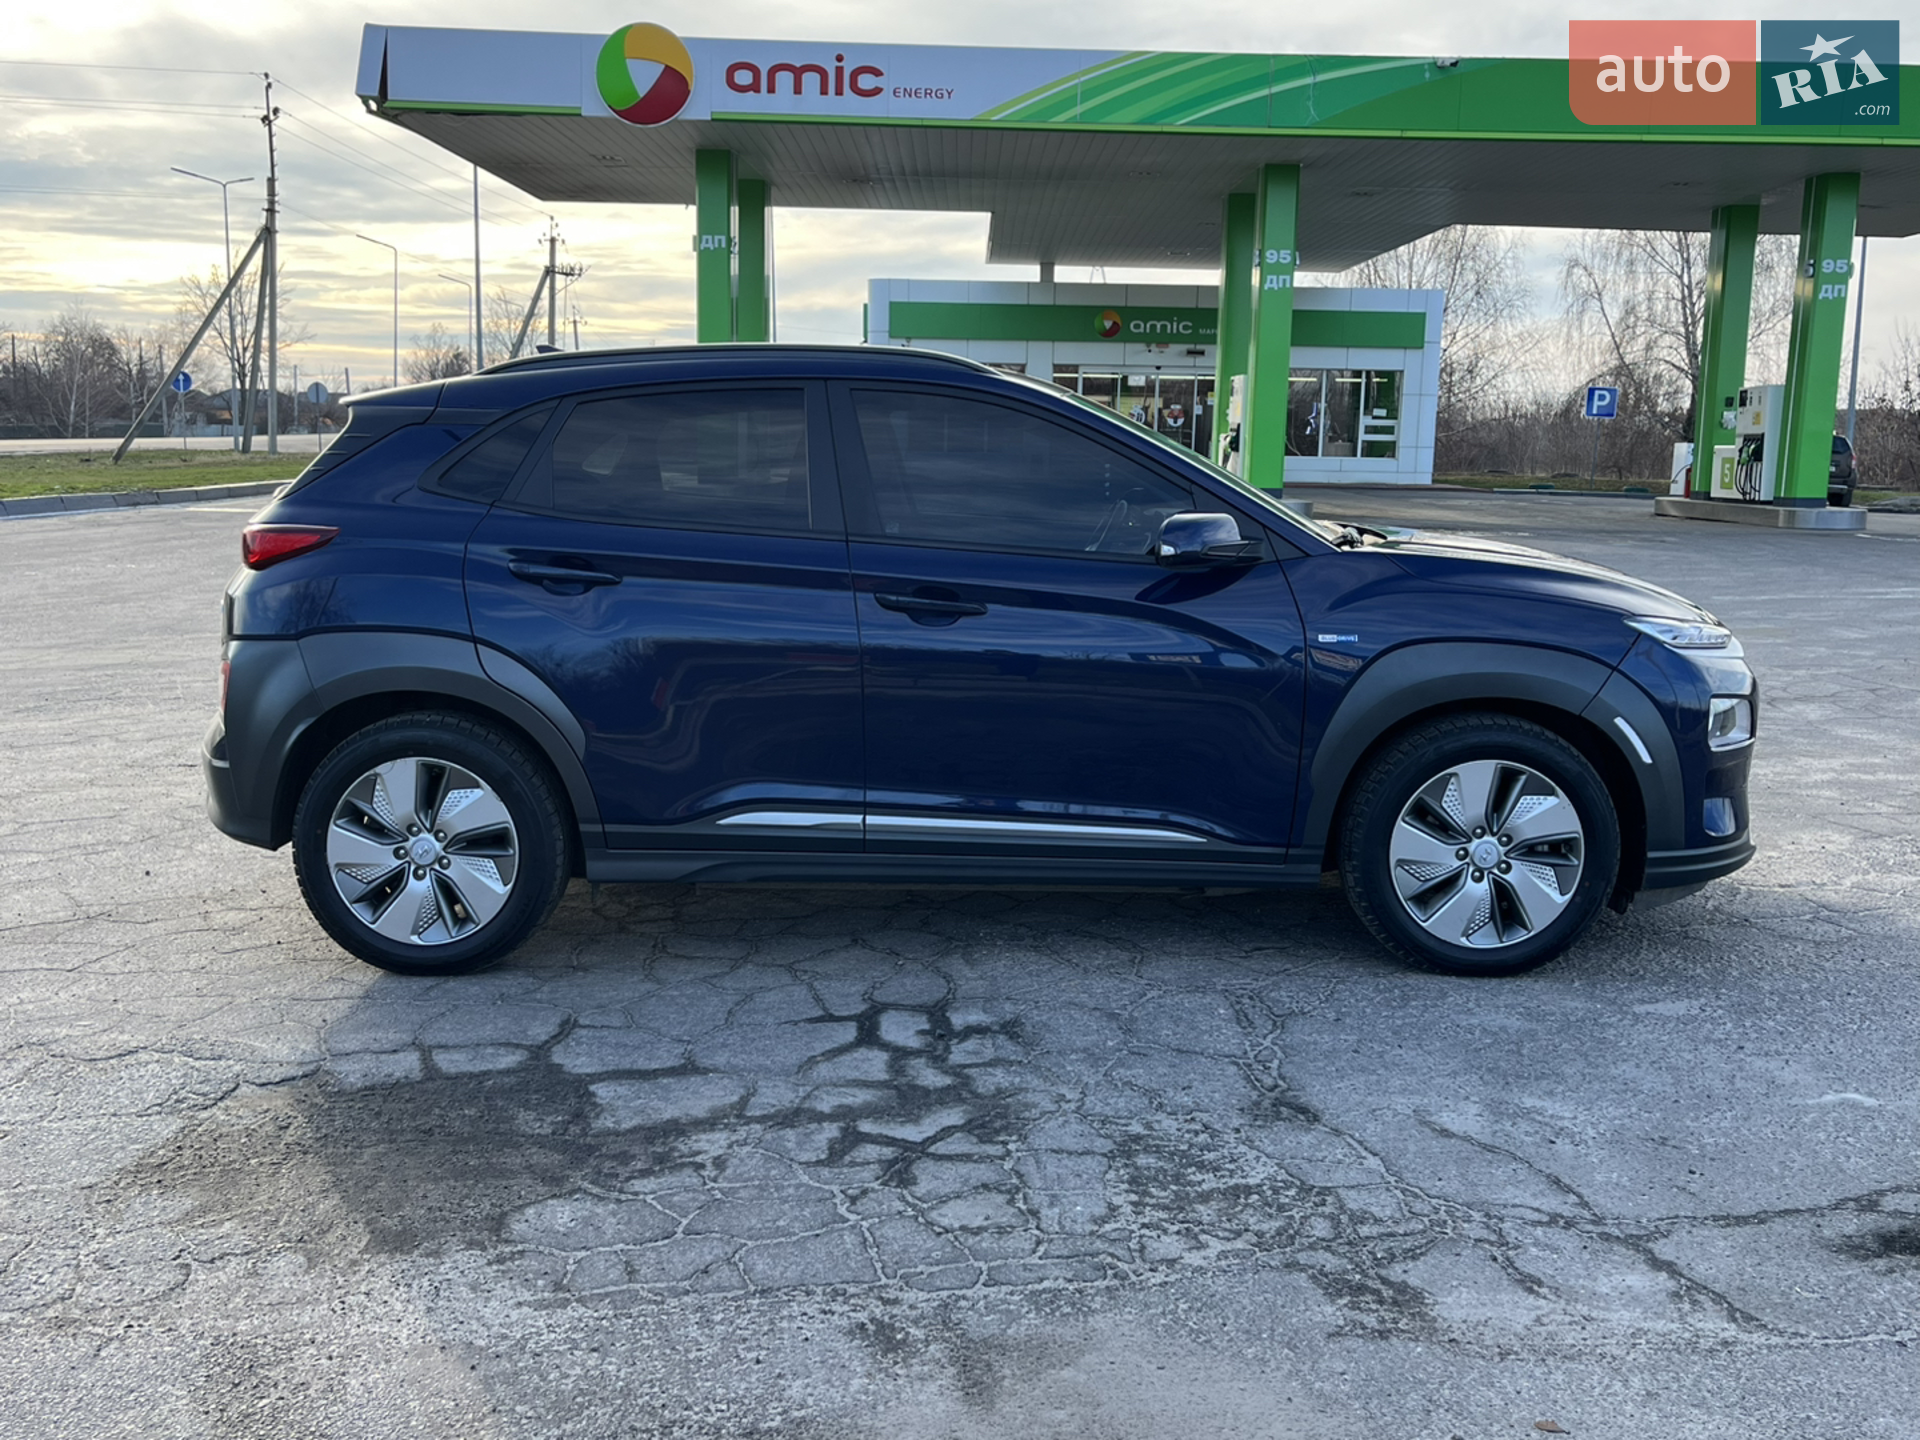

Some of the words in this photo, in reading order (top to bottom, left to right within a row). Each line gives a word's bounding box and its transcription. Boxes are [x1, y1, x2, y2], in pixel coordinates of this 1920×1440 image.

[725, 53, 885, 98] amic
[893, 87, 954, 100] ENERGY
[700, 235, 726, 250] ДП
[1265, 249, 1292, 264] 95
[1821, 258, 1849, 274] 95
[1264, 275, 1291, 291] ДП
[1818, 284, 1846, 300] ДП
[1129, 317, 1193, 334] amic
[1592, 390, 1611, 414] P
[1723, 464, 1731, 483] 5
